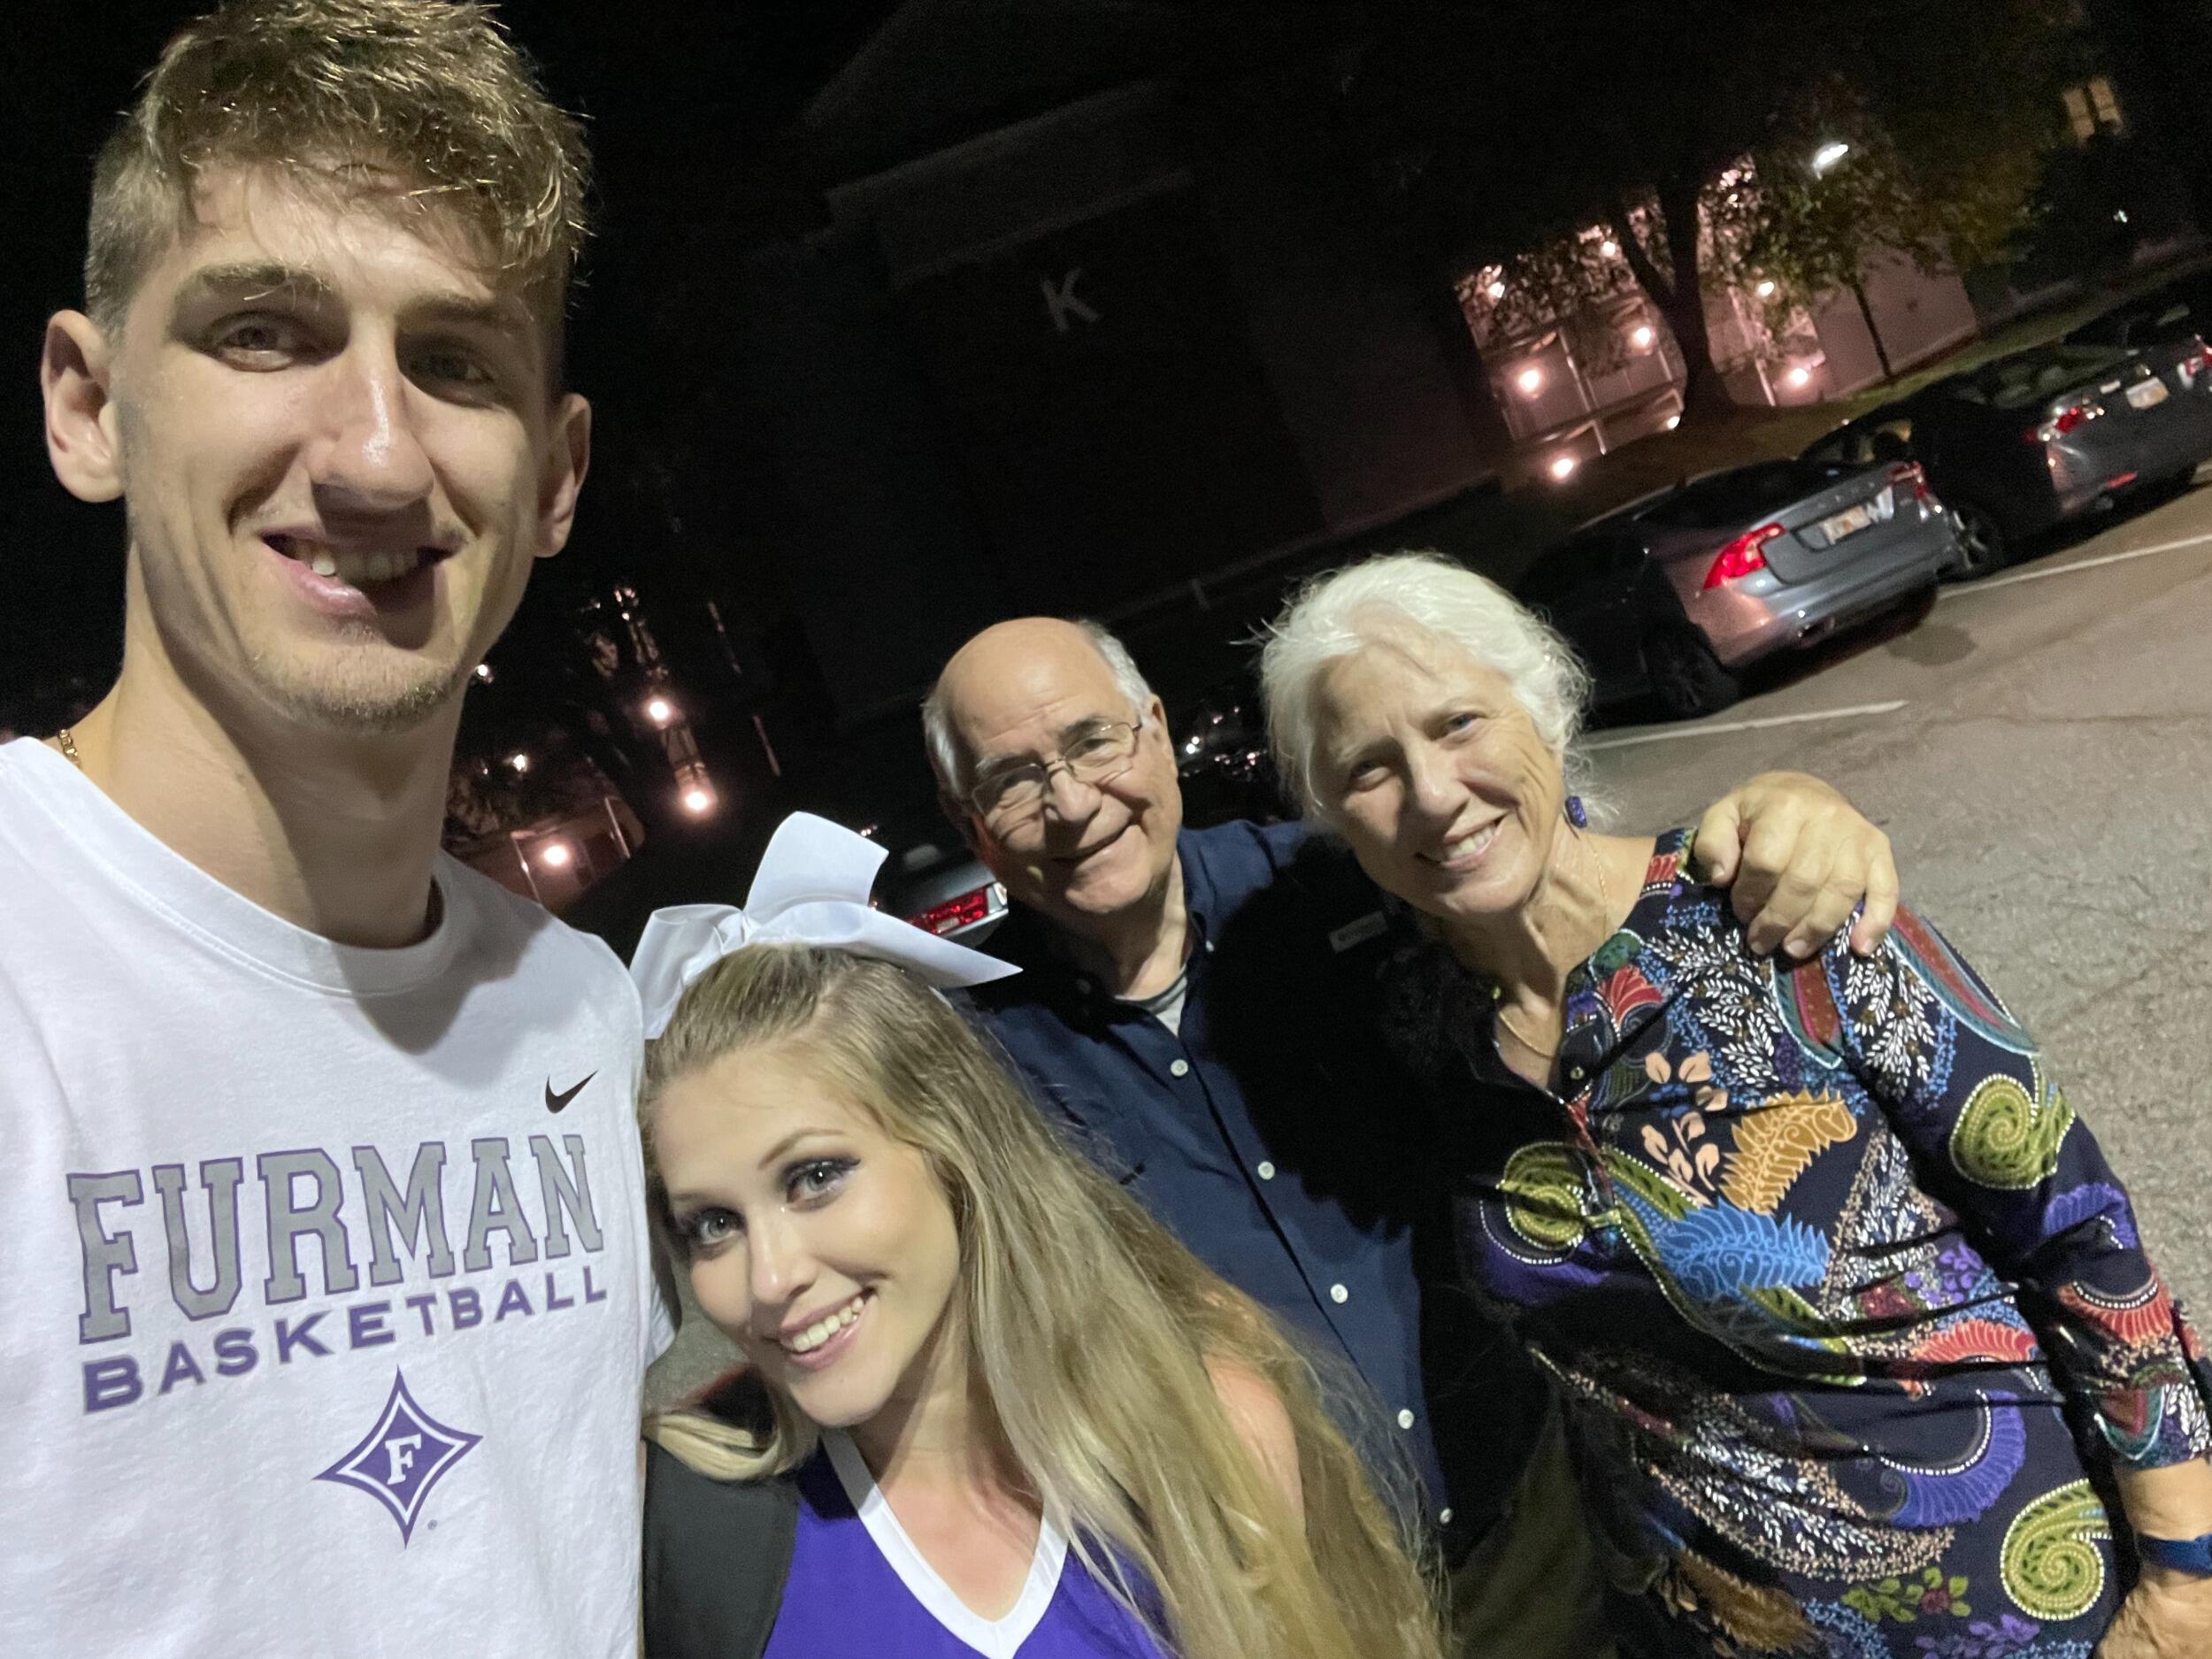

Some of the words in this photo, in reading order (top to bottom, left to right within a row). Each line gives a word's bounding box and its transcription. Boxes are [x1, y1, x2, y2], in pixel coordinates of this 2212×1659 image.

[1041, 267, 1100, 333] K
[66, 1134, 603, 1345] FURMAN
[82, 1266, 607, 1416] BASKETBALL
[384, 1433, 422, 1485] F
